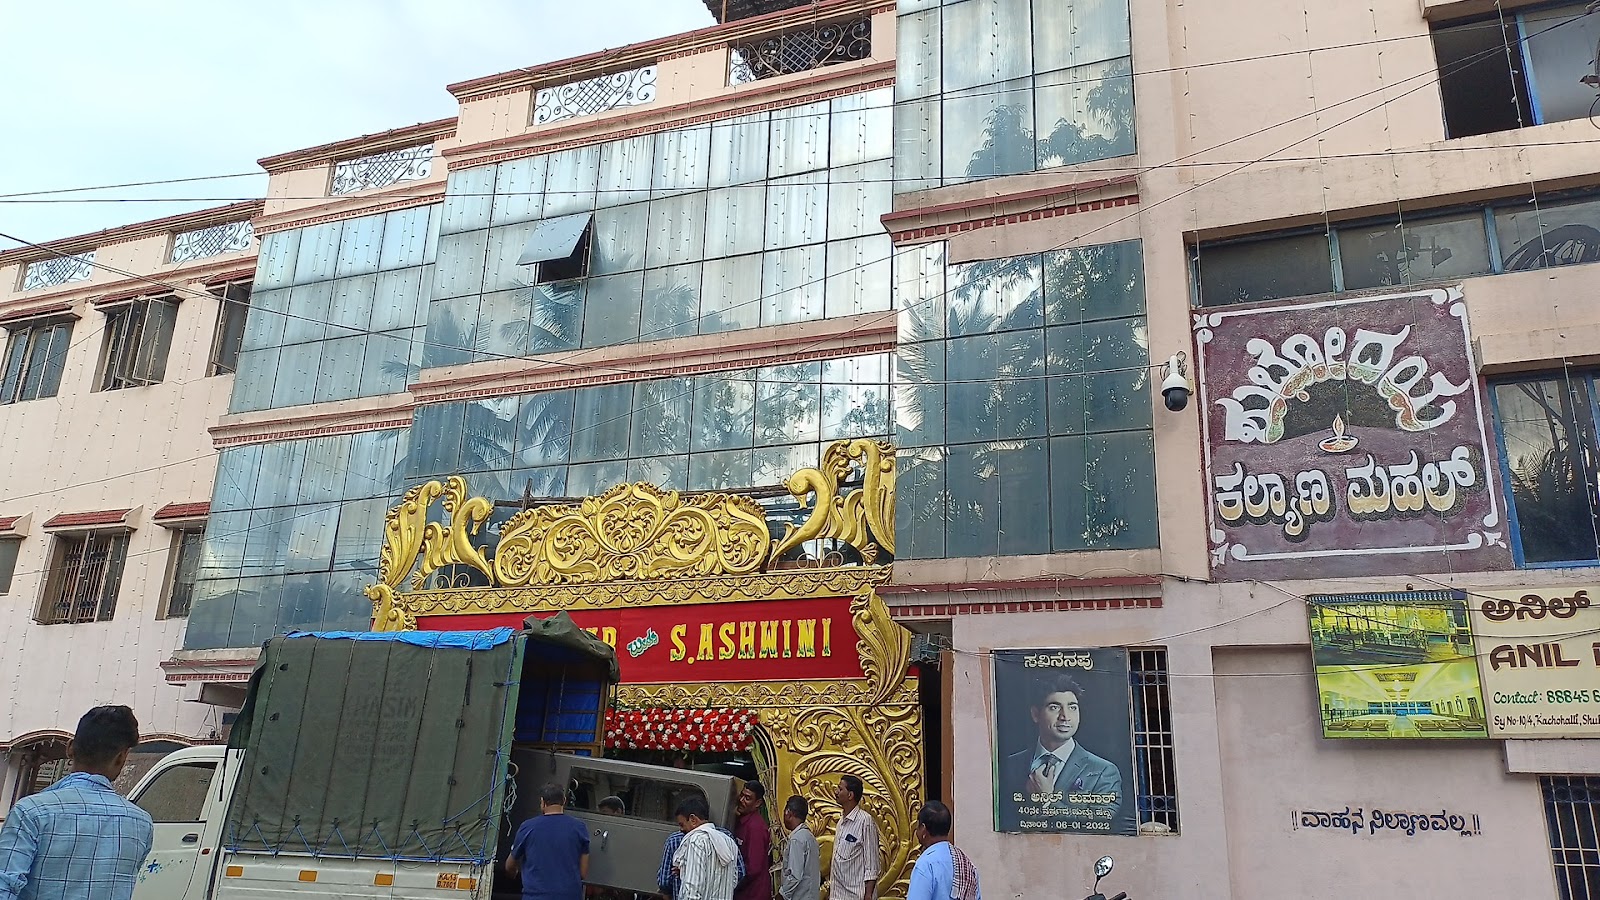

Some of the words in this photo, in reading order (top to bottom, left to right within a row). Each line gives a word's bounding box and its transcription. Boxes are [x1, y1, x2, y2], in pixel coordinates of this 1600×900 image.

[1215, 462, 1330, 536] ಕಲ್ಯಾಣ
[1346, 446, 1476, 514] ಮಹಲ್
[1481, 590, 1590, 621] ಅನಿಲ್
[669, 618, 832, 664] S.ASHWINI
[1023, 651, 1094, 671] ಸವಿನೆನಪು
[1489, 643, 1580, 671] ANIL
[1546, 689, 1590, 704] 88845
[1030, 790, 1063, 803] ಅನಿಲ್
[1068, 791, 1116, 804] ಕುಮಾರ್
[1055, 821, 1111, 830] 06-01-2022
[1301, 806, 1365, 834] ವಾಹನ
